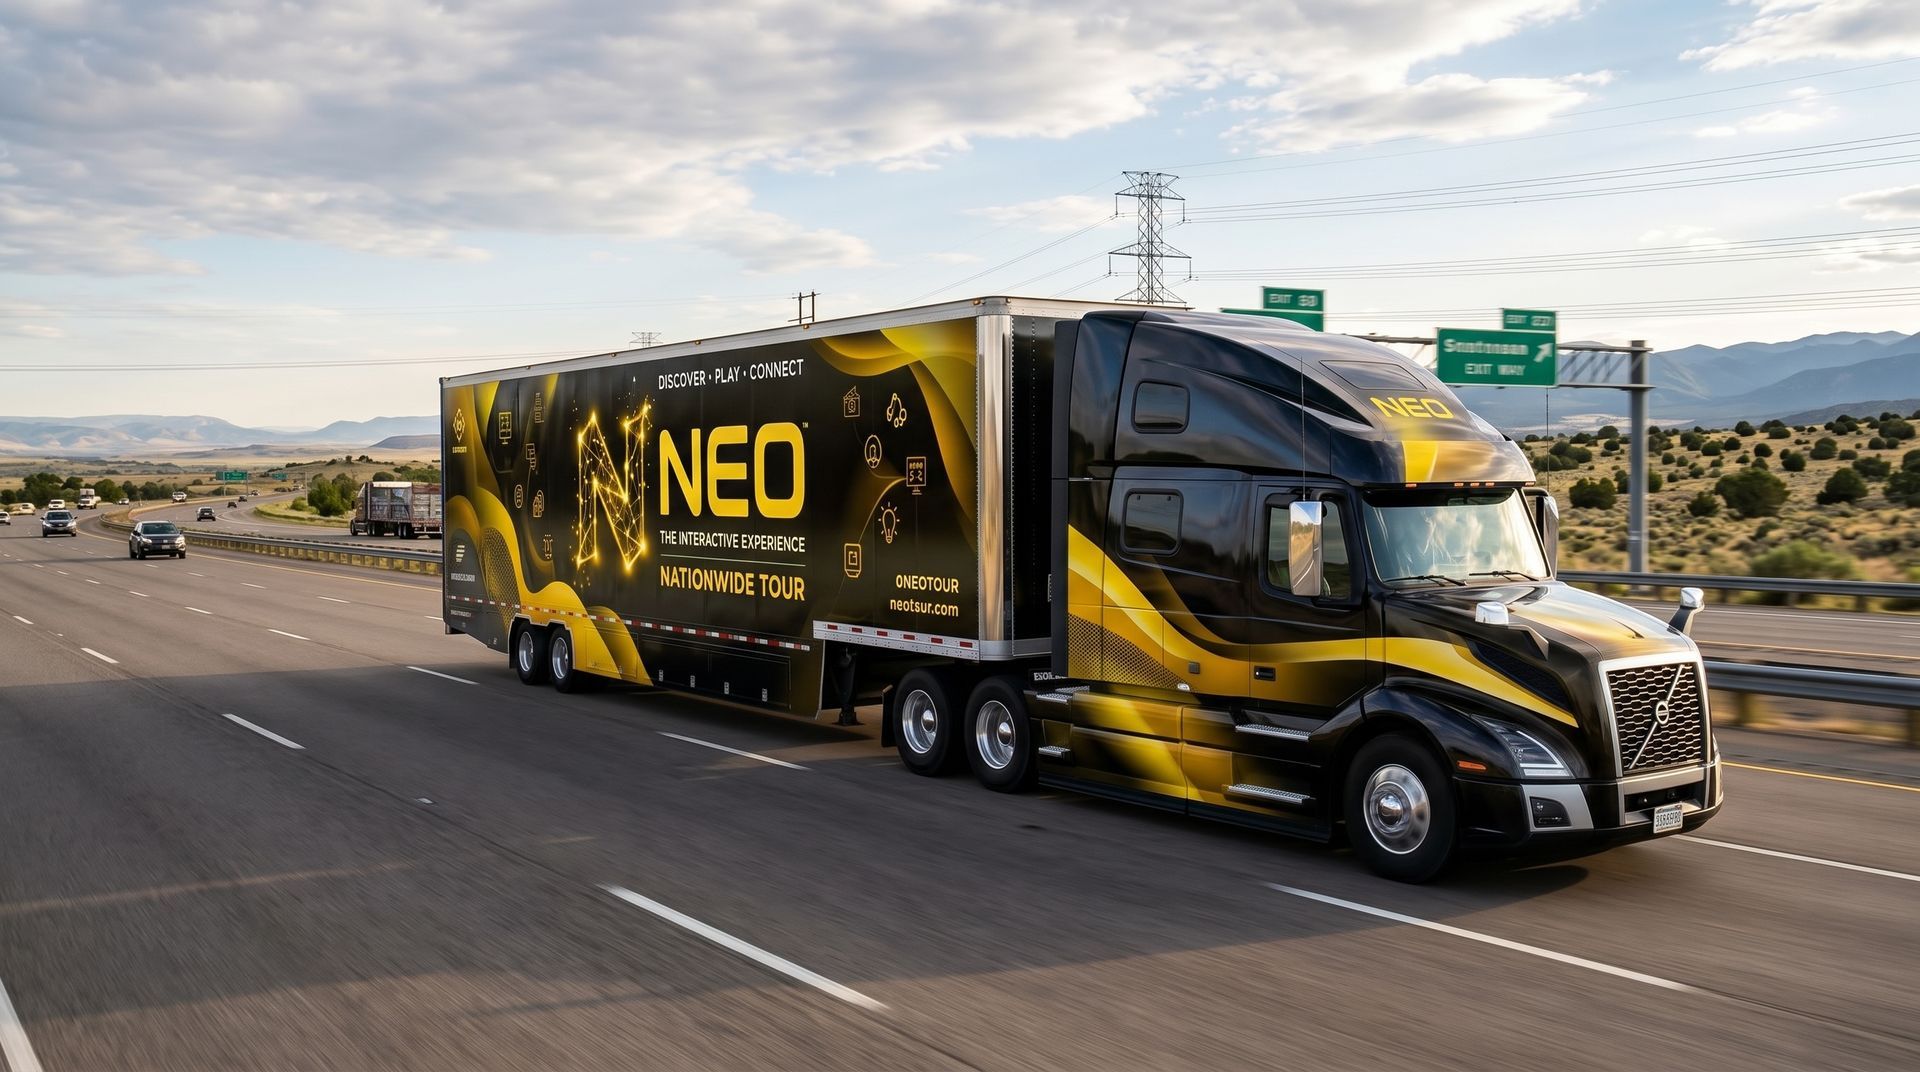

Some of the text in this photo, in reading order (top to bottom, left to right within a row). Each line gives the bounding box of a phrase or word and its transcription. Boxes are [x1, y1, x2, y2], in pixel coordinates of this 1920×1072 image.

[658, 358, 804, 390] DISCOVER PLAY CONNECT
[1369, 397, 1455, 419] NEO
[659, 422, 806, 519] NEO
[659, 530, 806, 553] THE INTERACTIVE EXPERIENCE
[660, 565, 806, 601] NATIONWIDE TOUR
[889, 599, 959, 617] neotsur.com
